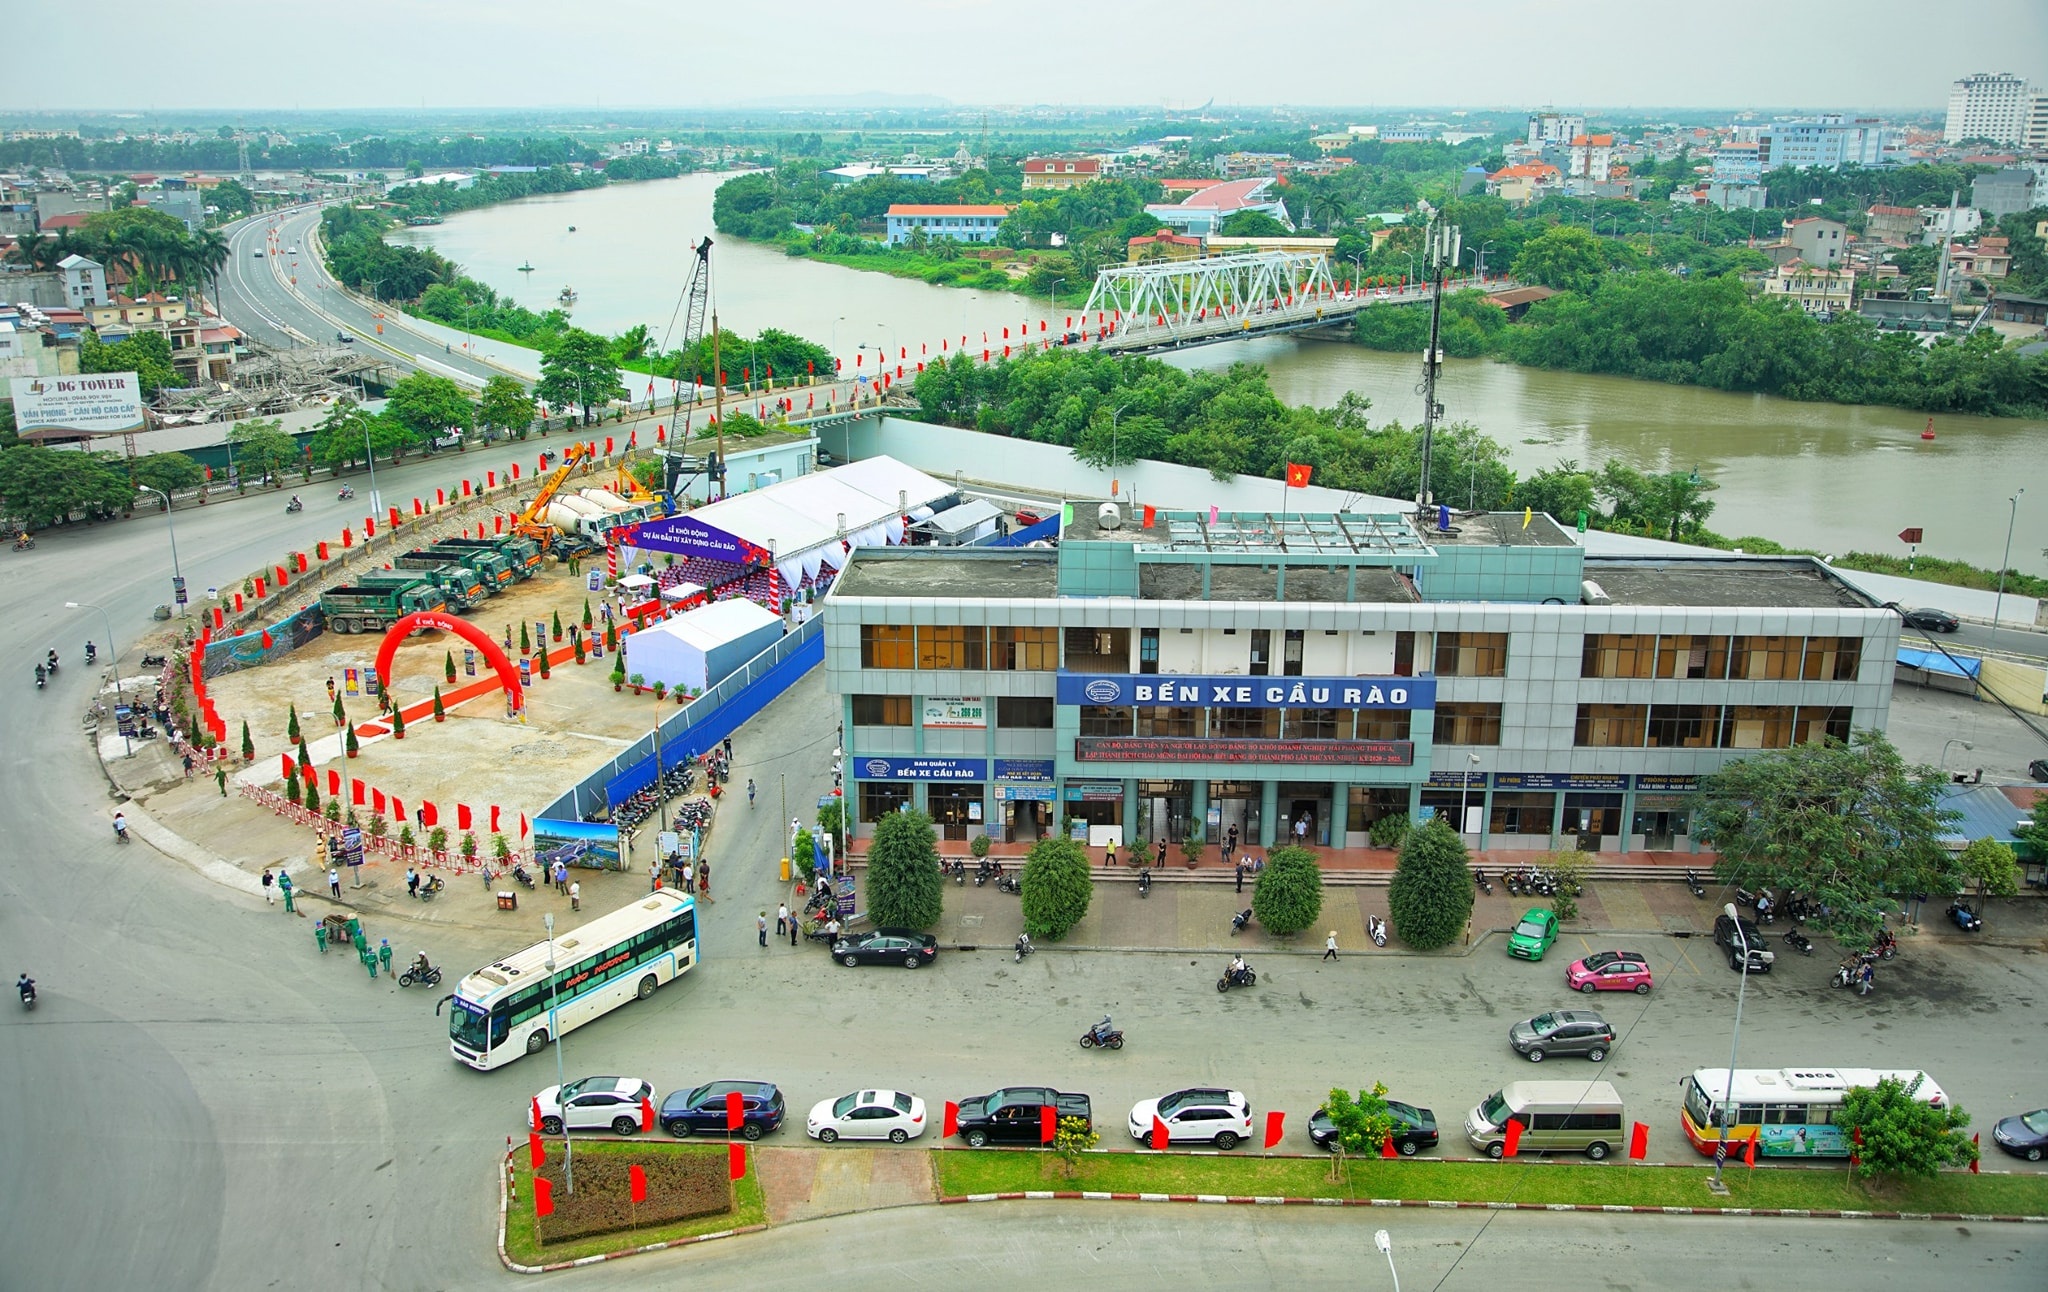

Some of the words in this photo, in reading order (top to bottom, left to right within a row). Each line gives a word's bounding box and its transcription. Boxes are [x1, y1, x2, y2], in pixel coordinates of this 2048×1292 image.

[57, 381, 76, 392] DG
[78, 379, 125, 390] TOWER
[668, 525, 675, 533] LỄ
[691, 530, 708, 538] ĐỘNG
[1136, 681, 1198, 702] BẾN
[1212, 687, 1251, 702] XE
[1266, 682, 1329, 703] CẦU
[1343, 685, 1407, 704] RÀO
[897, 767, 917, 777] BẾN
[933, 768, 953, 777] CẦU
[955, 769, 974, 777] RÀO
